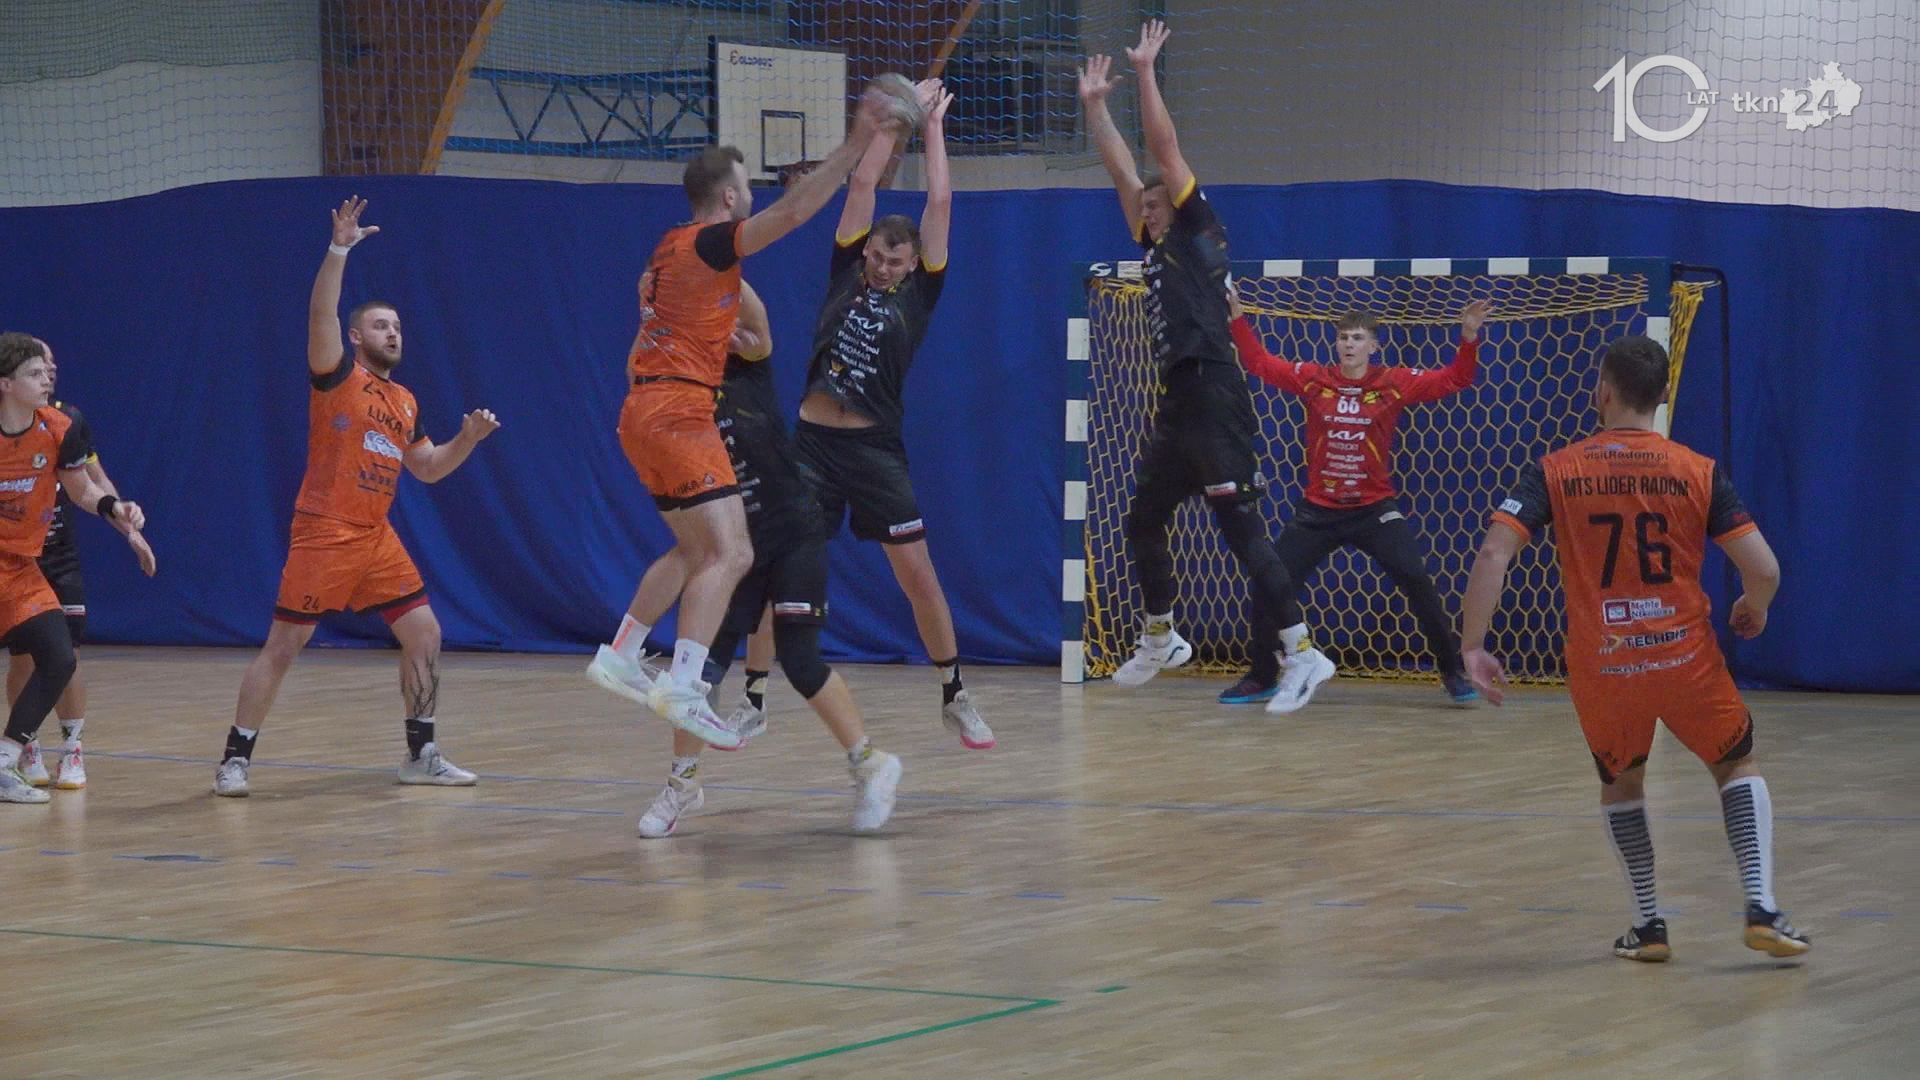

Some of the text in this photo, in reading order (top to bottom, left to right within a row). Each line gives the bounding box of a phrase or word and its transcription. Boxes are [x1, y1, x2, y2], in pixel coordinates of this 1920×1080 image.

[1336, 396, 1360, 414] 66
[367, 405, 403, 435] LUKA
[1563, 477, 1593, 497] MTS
[1597, 474, 1637, 496] LIDER
[1588, 512, 1674, 589] 76
[302, 595, 320, 611] 24
